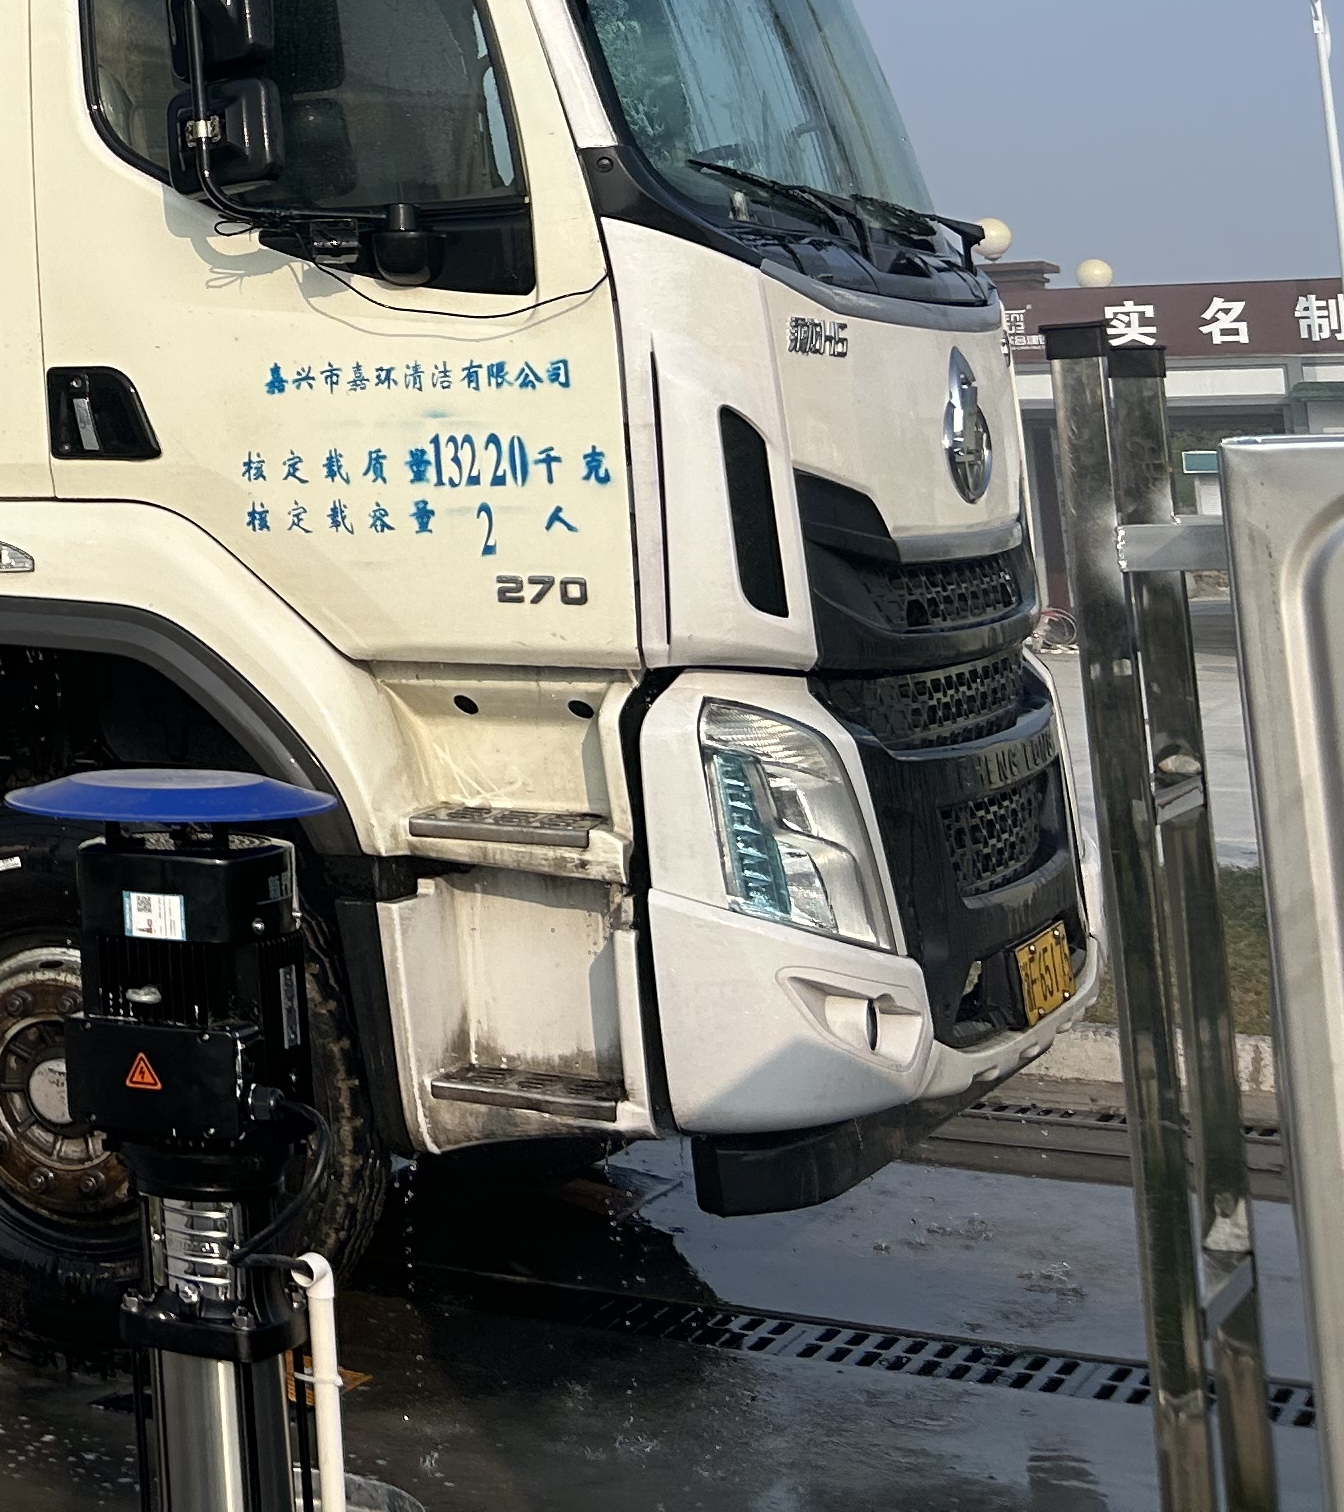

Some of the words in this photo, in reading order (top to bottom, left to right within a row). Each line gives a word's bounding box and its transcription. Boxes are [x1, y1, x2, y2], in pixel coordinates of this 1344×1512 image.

[265, 359, 572, 395] 嘉兴市嘉环清洁有限公司
[495, 574, 588, 606] 270
